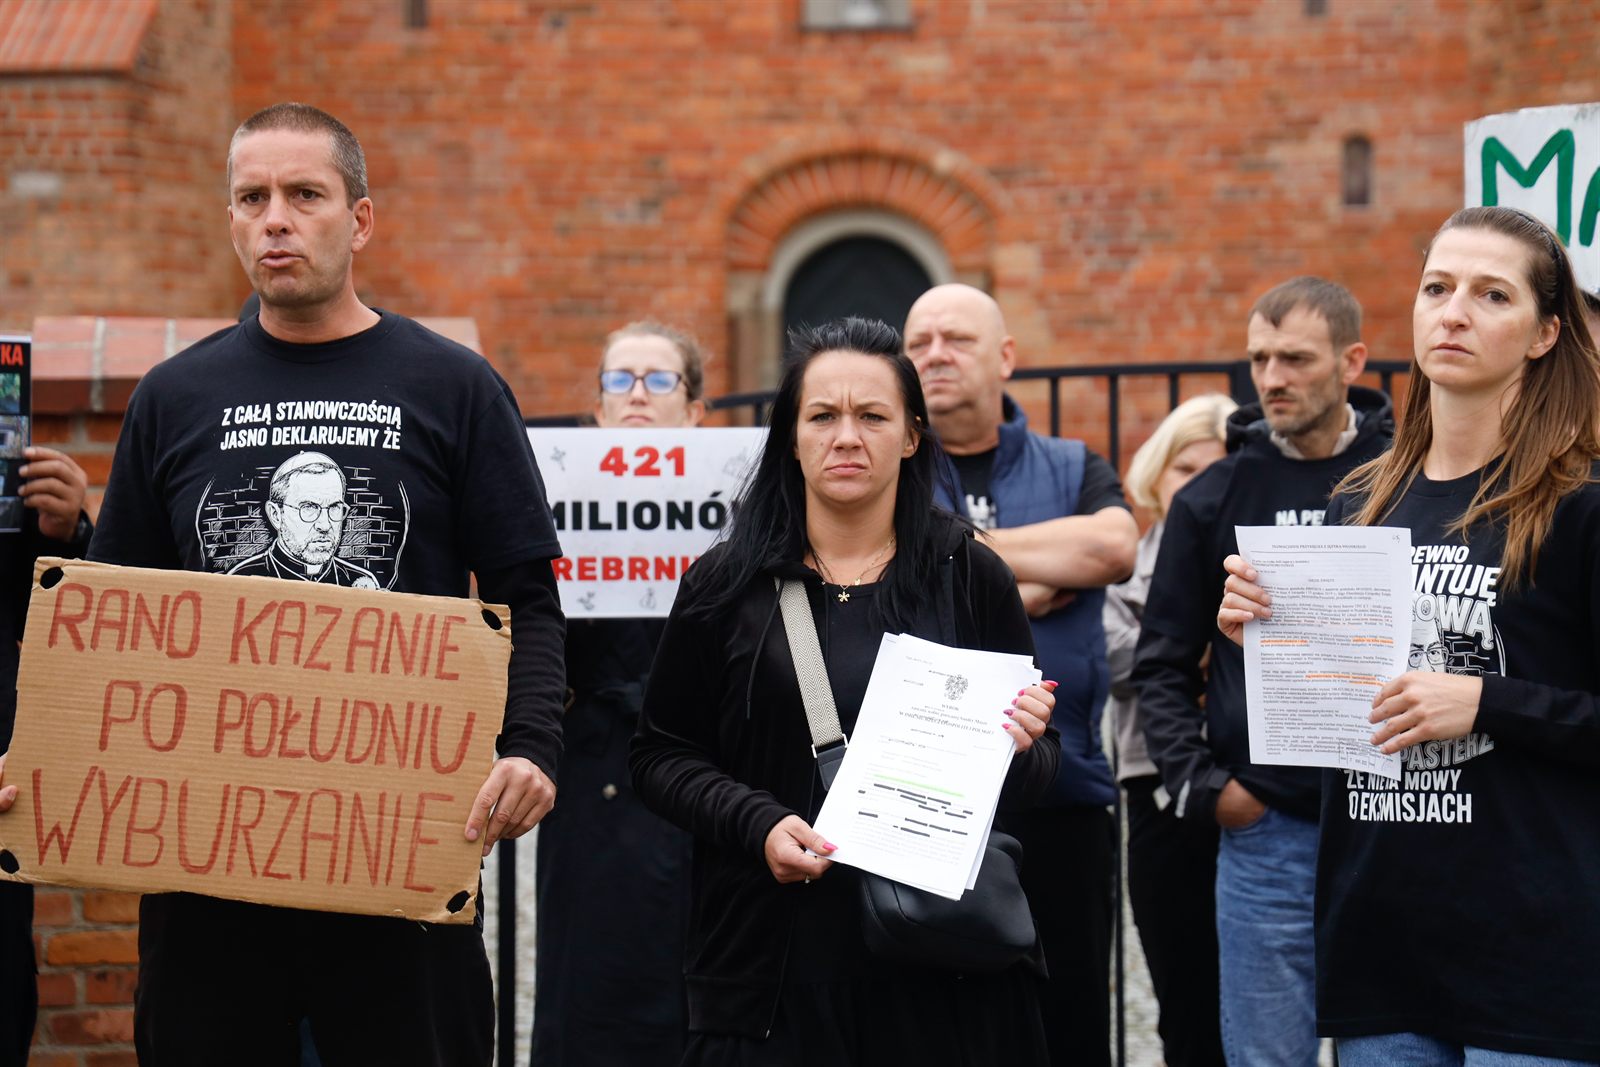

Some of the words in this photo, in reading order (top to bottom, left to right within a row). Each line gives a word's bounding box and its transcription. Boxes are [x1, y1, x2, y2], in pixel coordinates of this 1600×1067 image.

[221, 407, 233, 426] Z
[234, 403, 272, 425] CAŁĄ
[275, 399, 402, 430] STANOWCZOŚCIĄ
[220, 427, 268, 450] JASNO
[271, 425, 380, 447] DEKLARUJEMY
[382, 426, 401, 450] ŻE
[599, 446, 686, 477] 421
[550, 491, 734, 531] ILIONÓ
[1275, 509, 1298, 526] NA
[551, 555, 697, 582] REBRNI
[48, 582, 201, 660] RANO
[229, 598, 467, 681] KAZANIE
[1413, 593, 1494, 651] OWĄ
[98, 679, 188, 752] PO
[213, 688, 477, 775] POŁUDNIU
[1405, 769, 1462, 791] MOWY
[1348, 791, 1359, 820] O
[32, 766, 456, 894] WYBURZANIE
